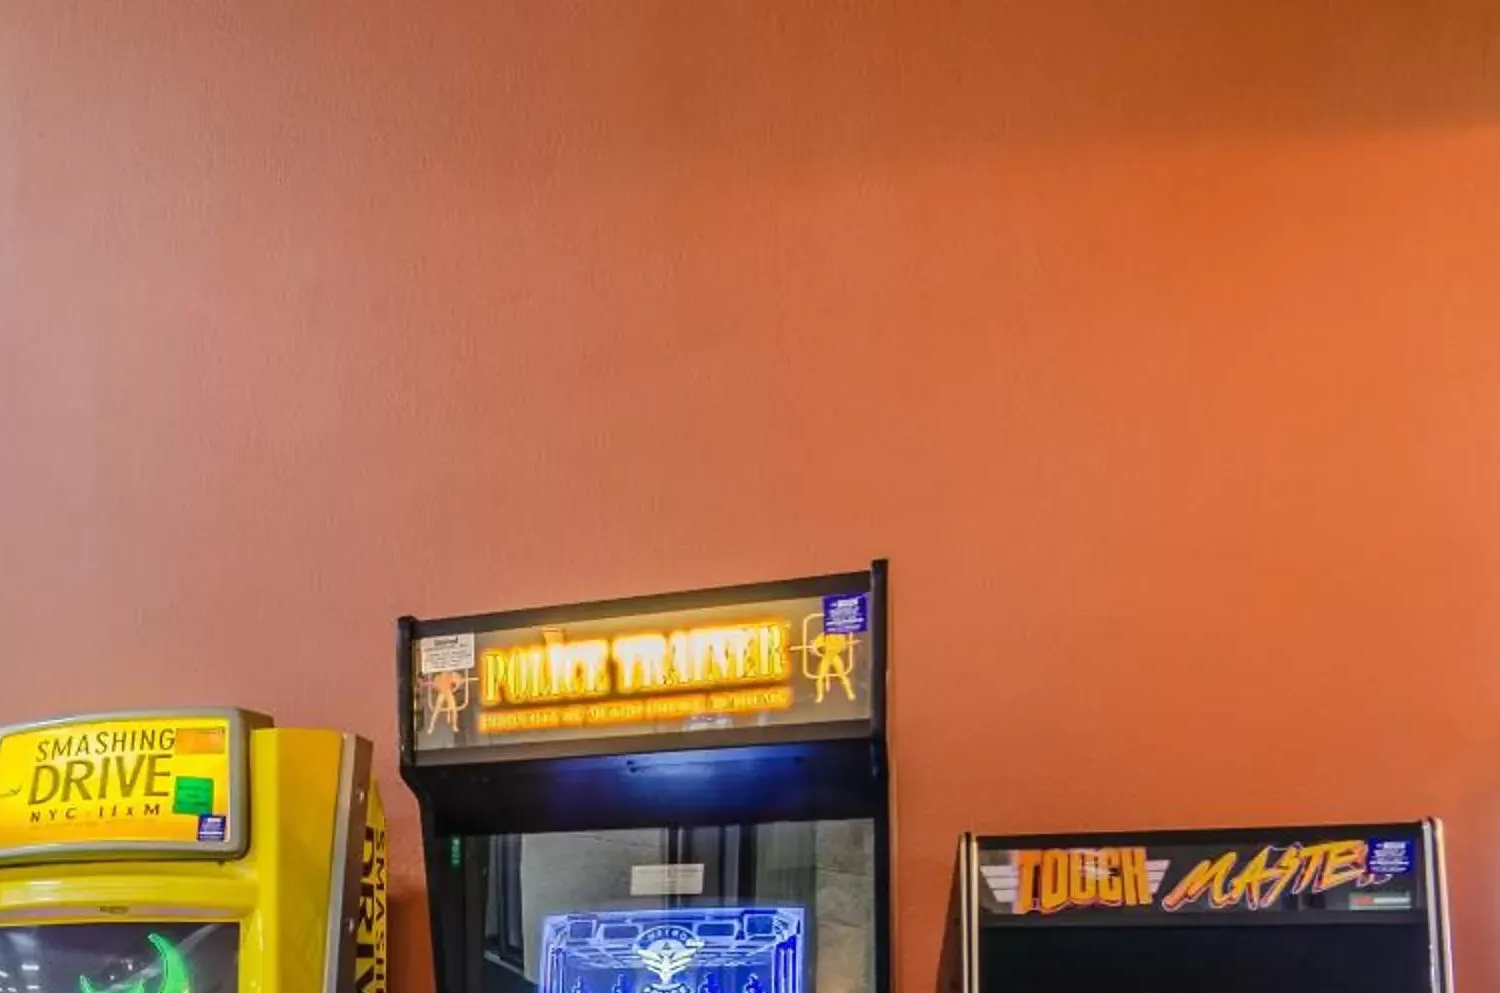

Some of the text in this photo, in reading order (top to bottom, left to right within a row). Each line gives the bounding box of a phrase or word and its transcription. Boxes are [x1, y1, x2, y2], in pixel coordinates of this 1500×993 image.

[484, 641, 609, 705] POLICE
[614, 623, 787, 694] TRAINER
[35, 728, 176, 763] SMASHING
[27, 754, 173, 806] DRIVE
[1012, 847, 1153, 915] TOUCH
